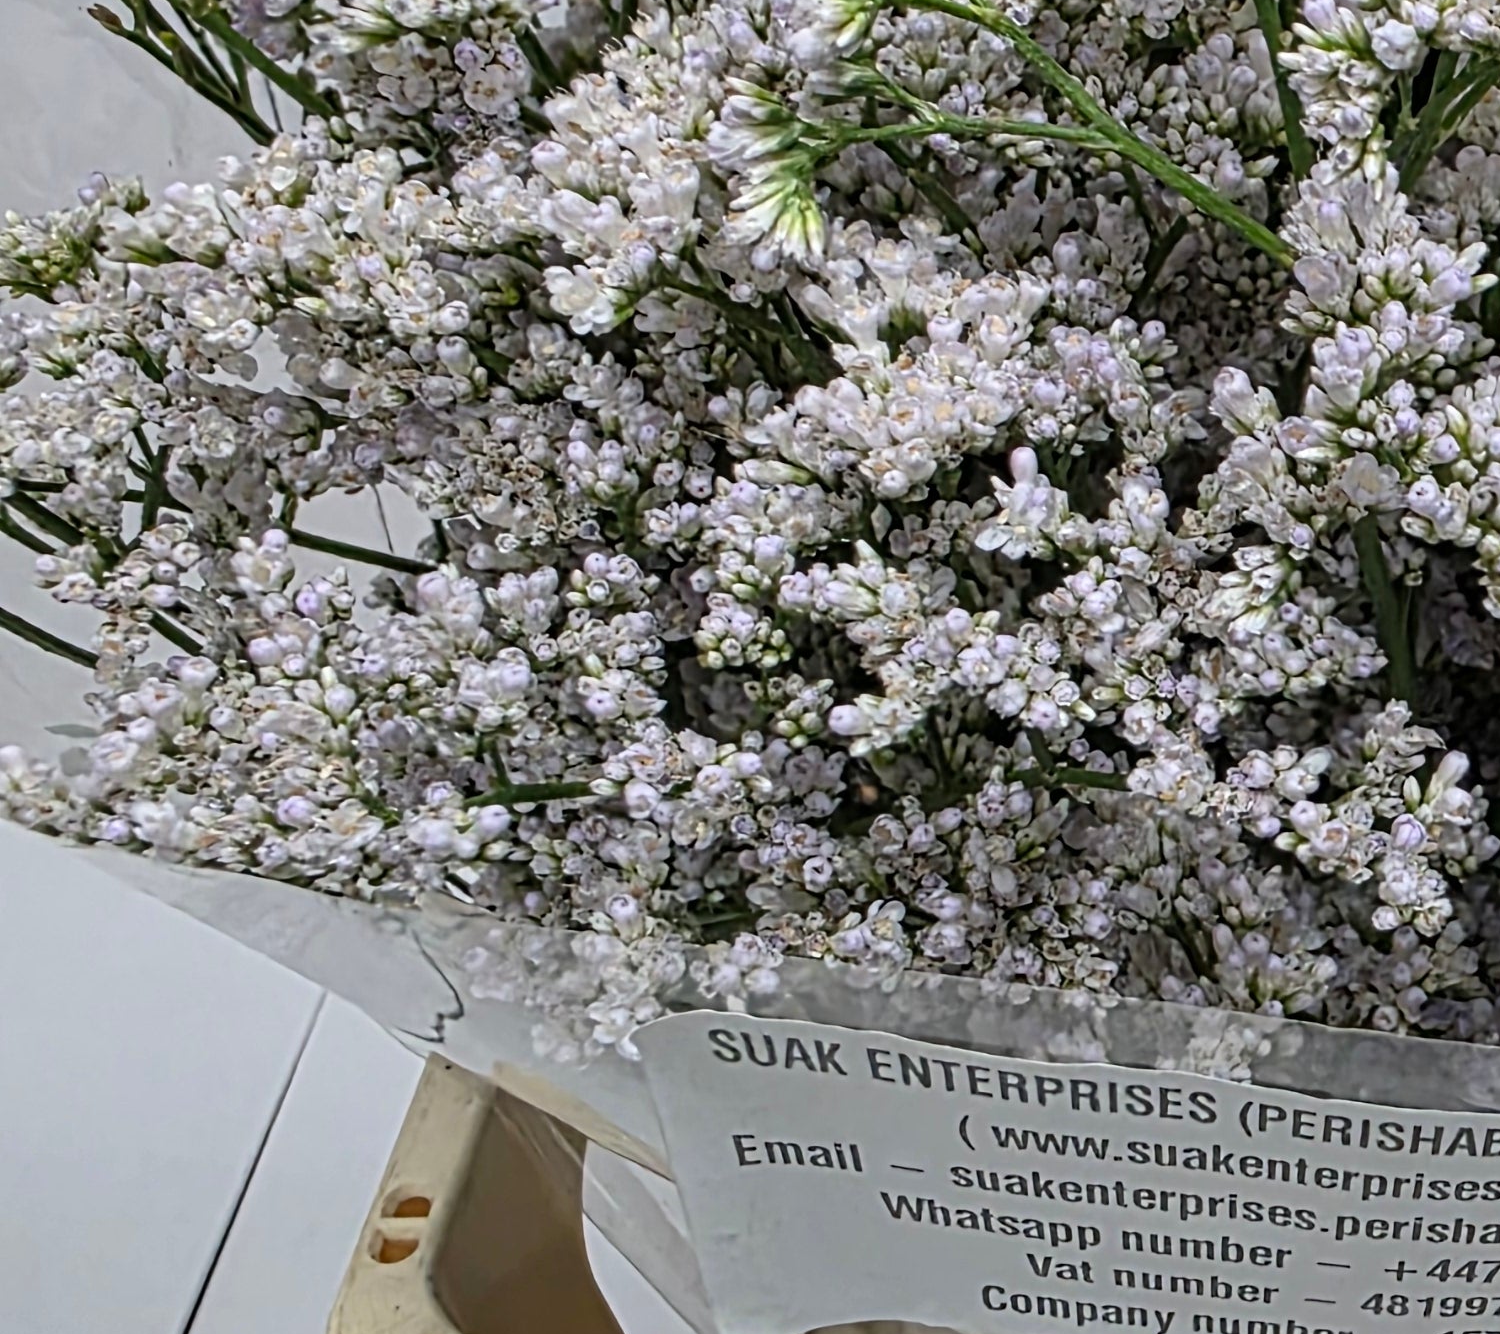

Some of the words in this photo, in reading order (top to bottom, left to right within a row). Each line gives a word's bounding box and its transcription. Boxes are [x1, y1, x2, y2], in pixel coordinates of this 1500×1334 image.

[708, 1028, 848, 1075] SUAK
[866, 1047, 1218, 1124] ENTERPRISES
[731, 1134, 863, 1172] Email
[880, 1191, 1102, 1250] Whatsapp
[1122, 1229, 1293, 1269] number
[1026, 1253, 1094, 1284] Vat
[1113, 1268, 1279, 1304] number
